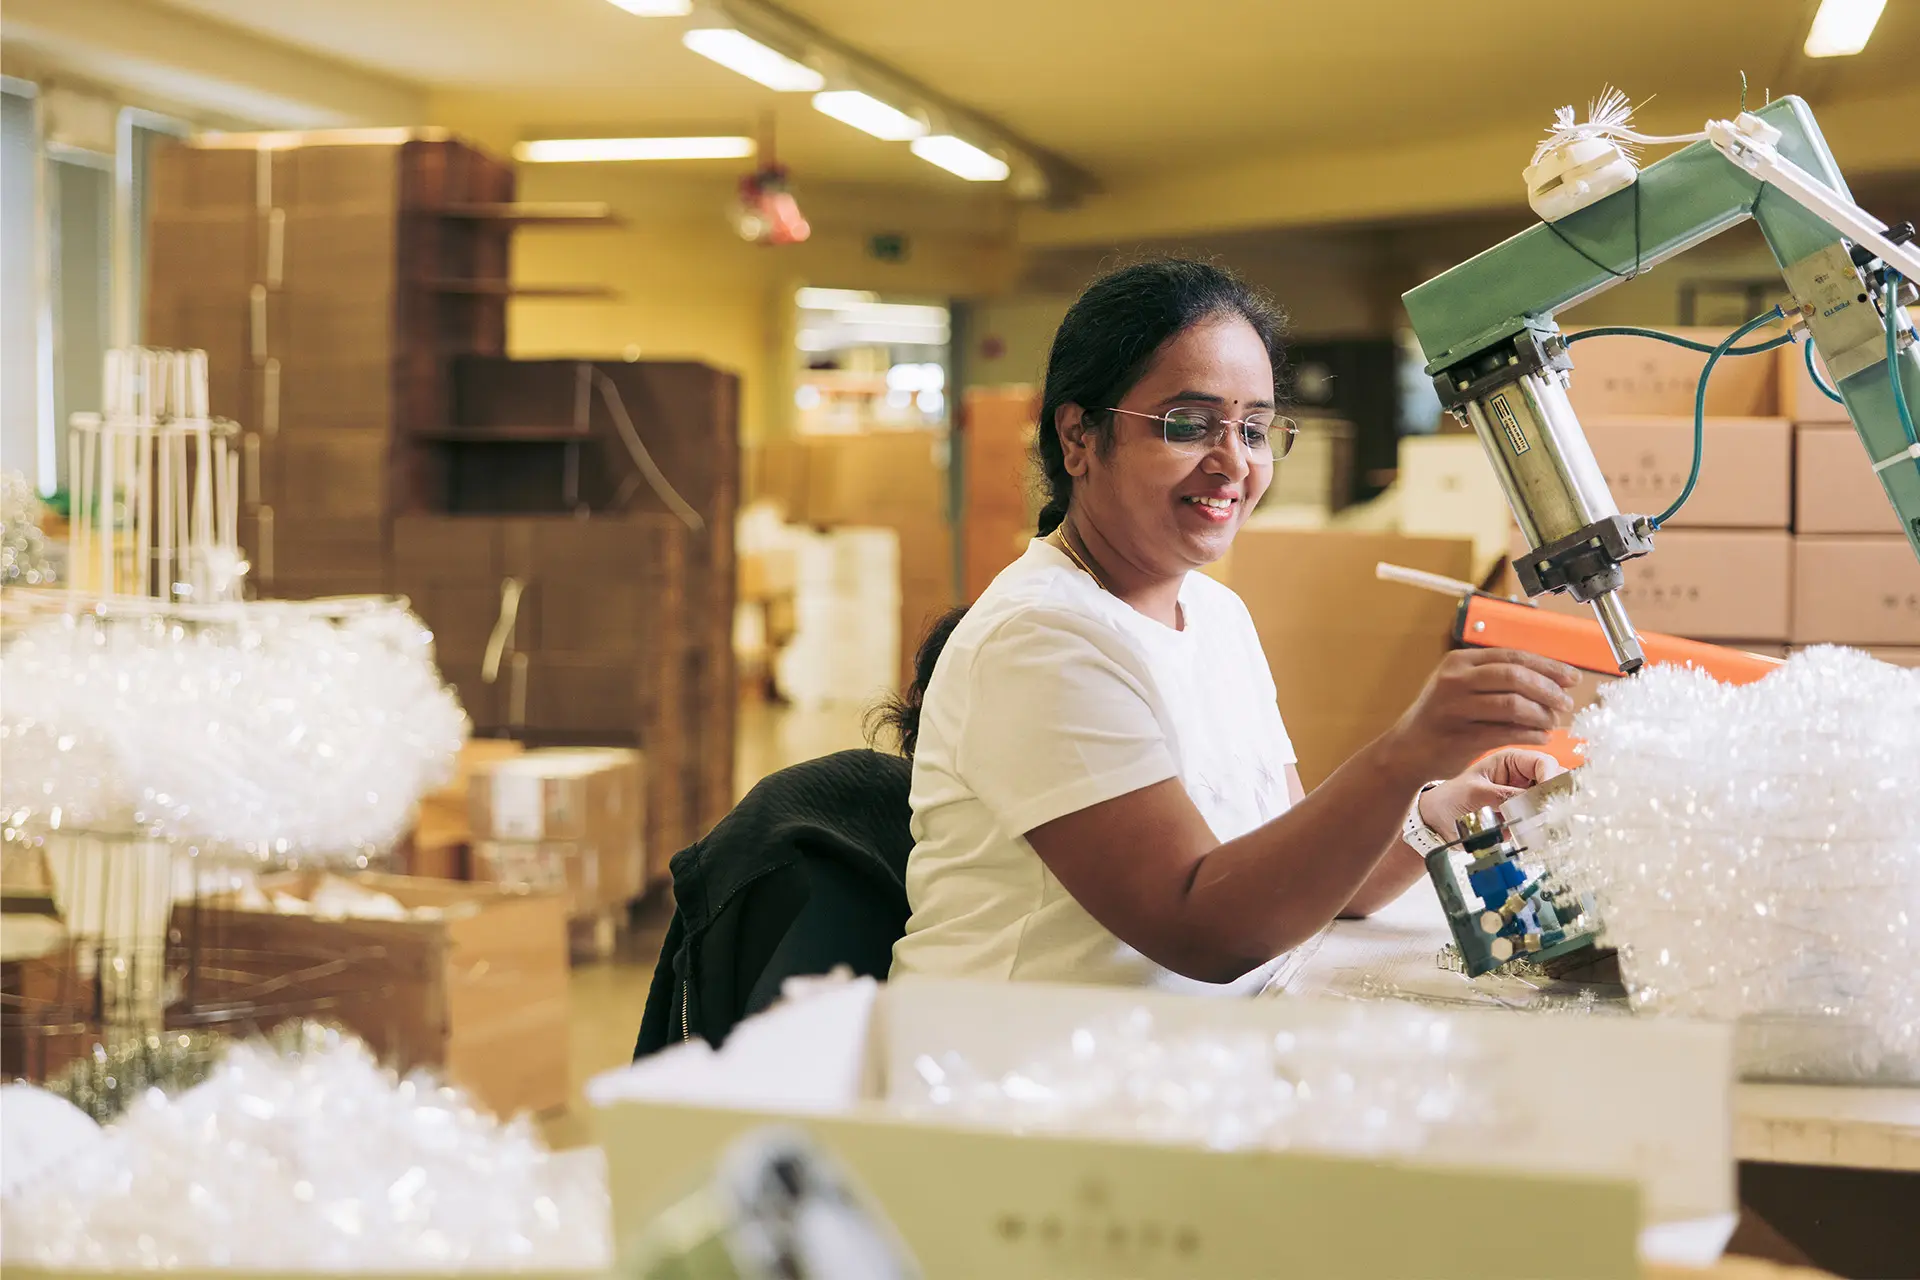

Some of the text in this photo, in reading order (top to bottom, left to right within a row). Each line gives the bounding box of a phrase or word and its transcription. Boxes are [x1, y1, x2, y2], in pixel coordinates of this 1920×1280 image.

[1824, 300, 1850, 317] FESTO
[1503, 419, 1521, 451] components
[1508, 418, 1526, 448] pneumatic
